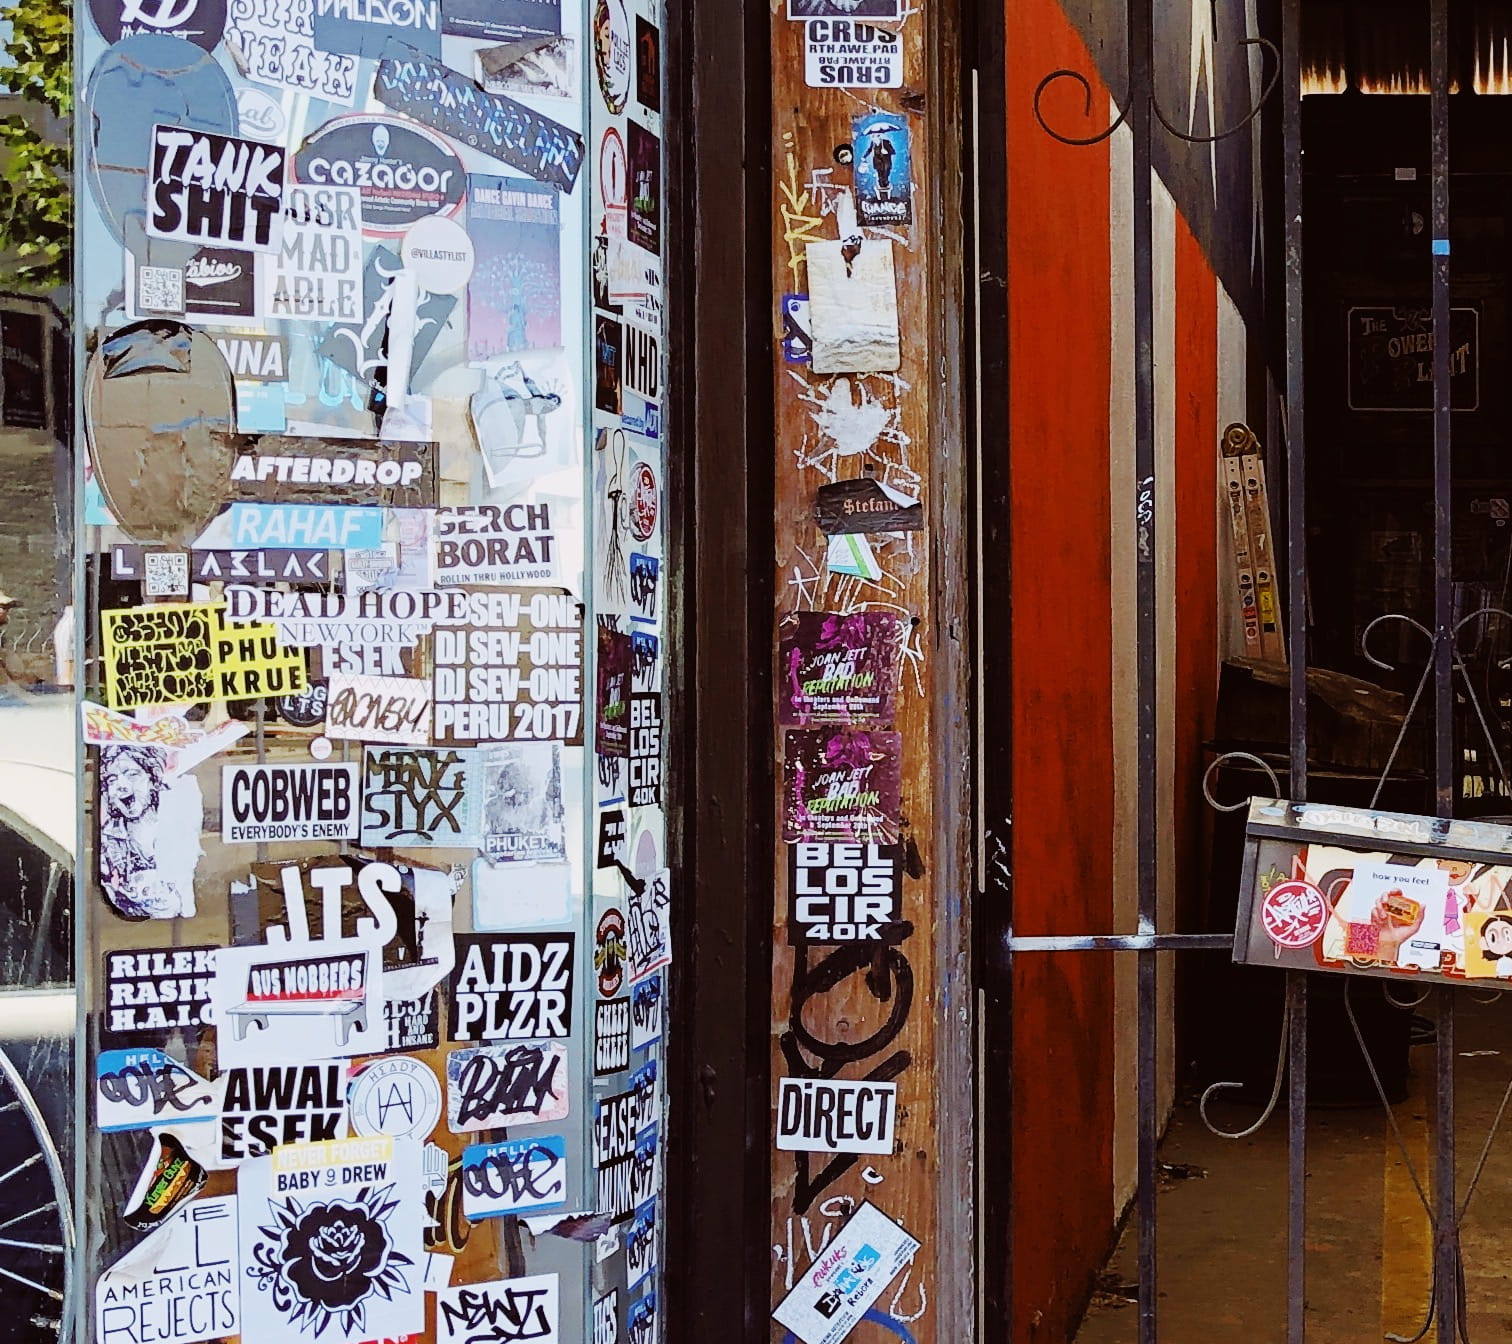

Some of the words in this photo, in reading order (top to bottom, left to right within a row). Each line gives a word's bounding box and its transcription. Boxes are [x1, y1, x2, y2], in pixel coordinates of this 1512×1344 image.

[808, 19, 897, 43] CRUS
[157, 132, 283, 197] TANK
[153, 177, 281, 245] SHIT
[625, 326, 658, 401] NHD
[231, 457, 422, 485] AFTERDROP
[237, 509, 363, 545] RAHAF
[439, 536, 553, 566] BORAT
[441, 573, 469, 582] ROLLIN
[473, 572, 496, 581] THRU
[500, 570, 551, 580] HOLLYWOOD
[228, 589, 345, 619] DEAD
[360, 590, 467, 620] HOPE
[219, 639, 300, 663] PHUN
[439, 636, 467, 664] DJ
[472, 632, 581, 664] SEV-ONE
[812, 652, 843, 667] JOAN
[845, 647, 868, 662] JETT
[222, 665, 302, 697] KRUE
[439, 672, 467, 701] DJ
[472, 669, 581, 697] SEV-ONE
[803, 672, 874, 695] REPUTATION
[822, 662, 854, 681] BAD
[437, 706, 501, 739] PERU
[517, 704, 581, 737] 2017
[631, 729, 659, 757] LOS
[631, 758, 659, 787] CIR
[233, 768, 350, 823] COBWEB
[231, 824, 307, 839] EVERYBODY'S
[313, 823, 349, 837] ENEMY
[487, 835, 546, 852] PHUKET
[796, 844, 892, 868] BEL
[795, 867, 892, 896] LOS
[1372, 871, 1392, 881] how
[1394, 874, 1410, 885] you
[1413, 874, 1430, 886] feel
[267, 864, 400, 946] JTS
[795, 896, 893, 924] CIR
[805, 924, 883, 941] 40K
[458, 943, 569, 990] AIDZ
[456, 994, 569, 1040] PLZR
[222, 1065, 343, 1112] AWAL
[222, 1113, 335, 1160] ESEK
[279, 1143, 326, 1165] NEVER
[332, 1140, 389, 1161] FORGET
[103, 1269, 233, 1301] AMERICAN
